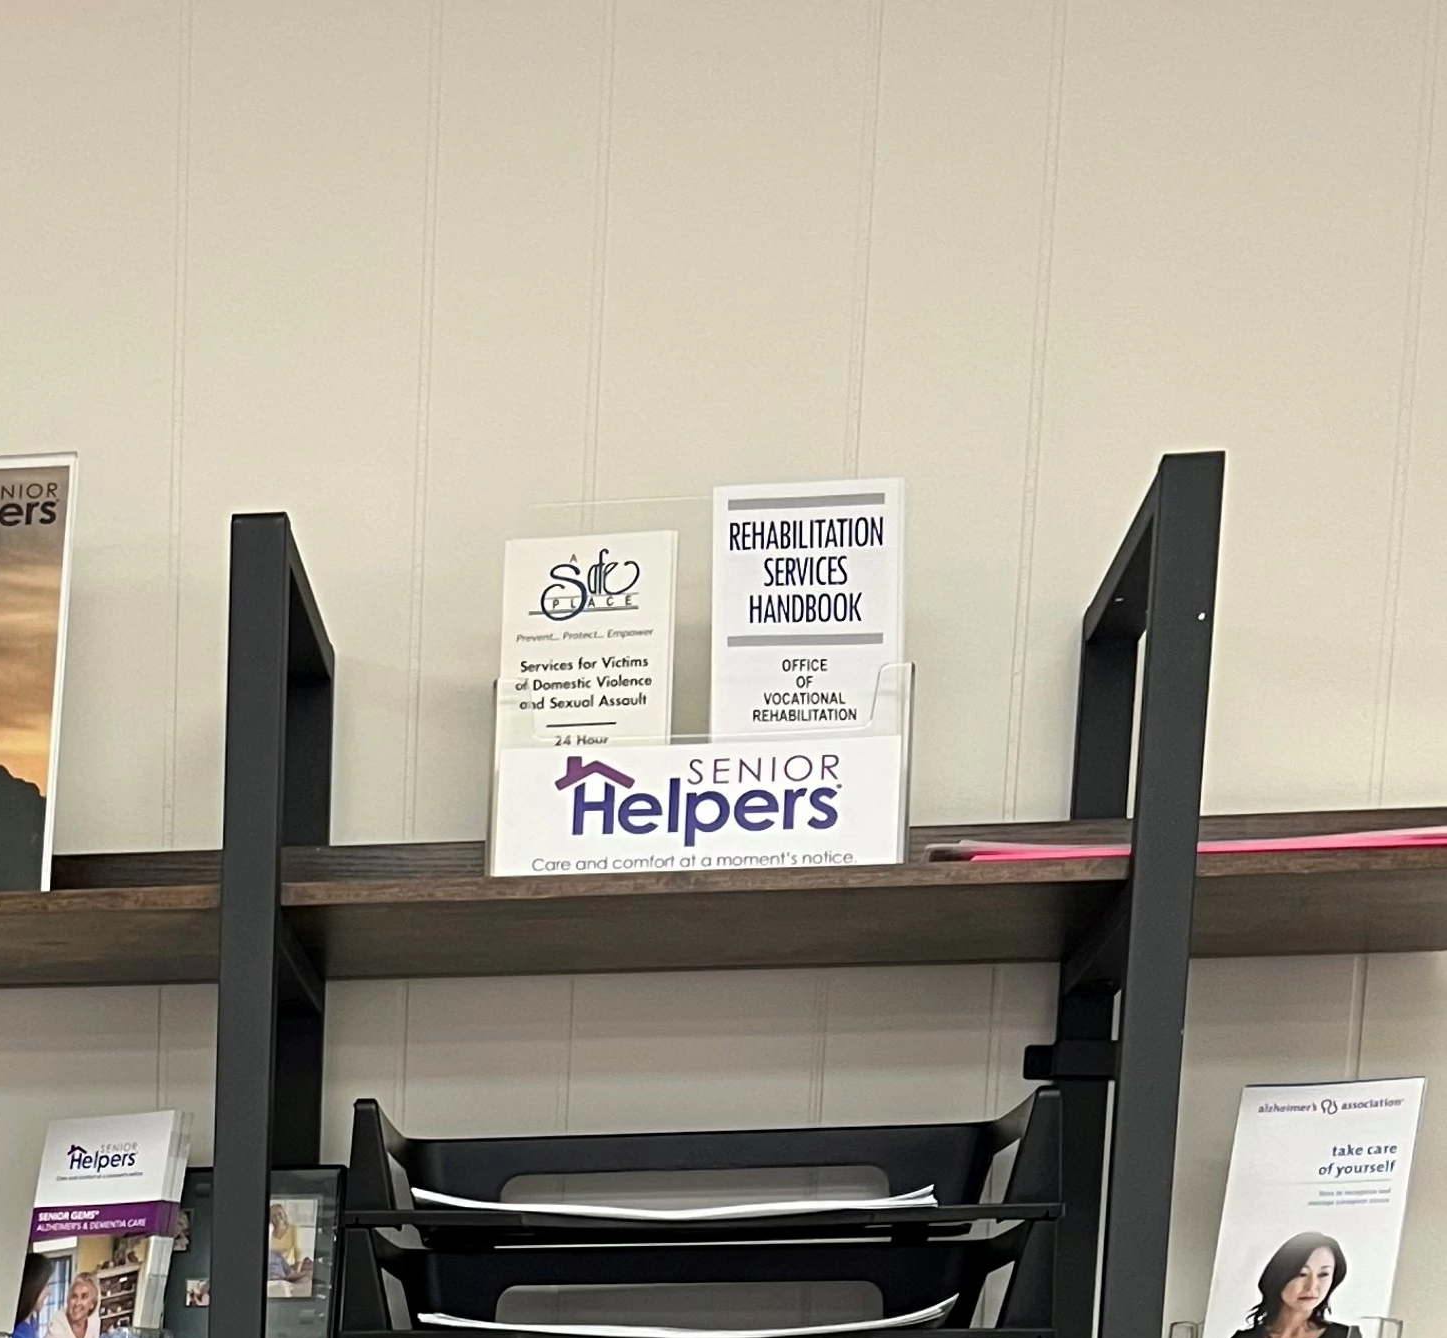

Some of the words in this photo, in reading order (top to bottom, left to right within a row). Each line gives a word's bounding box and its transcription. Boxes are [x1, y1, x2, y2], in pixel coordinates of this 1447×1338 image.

[729, 517, 884, 551] REHABILITATION
[764, 556, 847, 586] SERVICES
[749, 593, 862, 624] HANDBOOK
[607, 629, 653, 639] Empower
[521, 660, 573, 672] Services
[578, 657, 597, 669] for
[602, 656, 648, 668] Victims
[782, 659, 827, 672] OFFICE
[533, 677, 591, 690] Domestic
[597, 675, 652, 687] Violence
[796, 676, 813, 688] OF
[520, 697, 544, 709] and
[550, 695, 594, 709] Sexual
[599, 692, 647, 706] Assault
[764, 693, 846, 705] VOCATIONAL
[752, 708, 857, 722] REHABILITATION
[555, 735, 571, 746] 24
[577, 735, 609, 745] Hour
[688, 754, 839, 785] SENIOR
[572, 778, 838, 847] Helpers
[532, 858, 570, 872] Care
[576, 857, 607, 870] and
[613, 856, 674, 869] comfort
[680, 855, 696, 868] at
[701, 858, 711, 867] a
[717, 852, 798, 866] moment's
[802, 851, 857, 865] notice.
[1258, 1101, 1317, 1114] alzheimer's
[101, 1142, 138, 1152] SENIOR
[1332, 1144, 1364, 1156] take
[1367, 1143, 1397, 1155] care
[70, 1150, 135, 1172] Helpers
[1319, 1162, 1334, 1176] of
[1336, 1161, 1396, 1178] yourself
[39, 1211, 69, 1221] SENIOR
[90, 1219, 127, 1229] DEMENTIA
[128, 1219, 146, 1228] CARE
